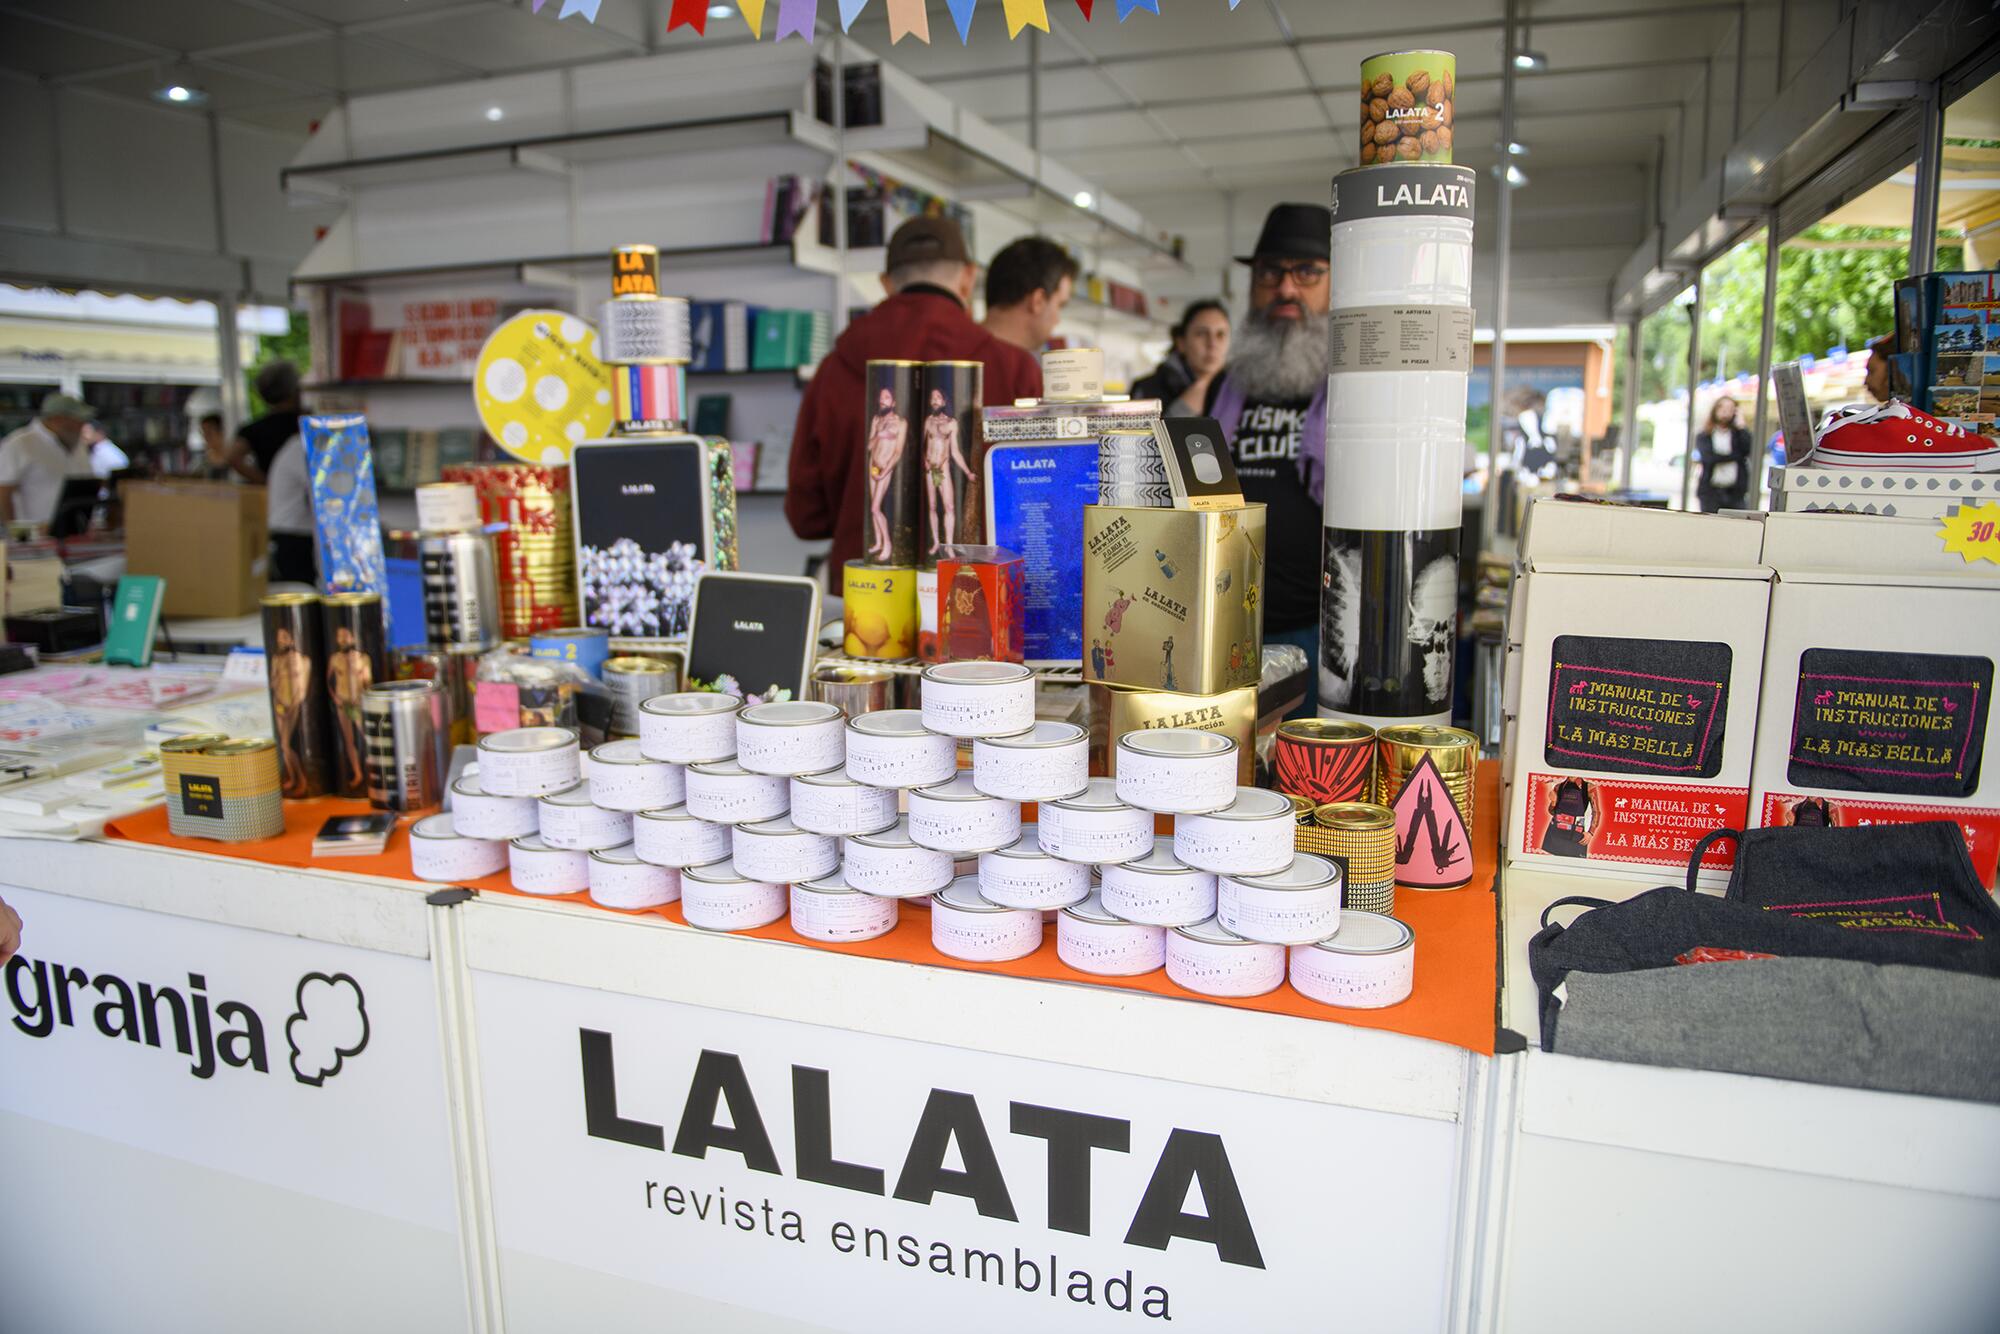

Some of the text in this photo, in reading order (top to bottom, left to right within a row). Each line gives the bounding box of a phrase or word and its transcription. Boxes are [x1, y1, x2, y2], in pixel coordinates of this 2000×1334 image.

[1386, 102, 1445, 122] LALATA 2
[1377, 183, 1469, 209] LALATA
[619, 251, 645, 272] LA
[613, 274, 657, 294] LATA
[1011, 459, 1057, 470] LALATA
[1966, 520, 1995, 543] 30
[883, 577, 894, 593] 2
[1144, 586, 1188, 617] LA LATA
[565, 642, 577, 660] 2
[1588, 681, 1684, 707] MANUAL DE
[1837, 690, 1939, 712] MANUAL DE
[1172, 705, 1223, 728] LATA
[1569, 696, 1697, 726] INSTRUCCIONES
[1815, 707, 1954, 730] INSTRUCCIONES
[1558, 725, 1694, 758] LA MAS BELLA
[1802, 737, 1953, 764] LA MAS BELLA
[1631, 798, 1711, 815] MANUAL DE
[1613, 811, 1726, 830] INSTRUCCIONES
[1605, 832, 1628, 848] LA
[1632, 834, 1669, 851] MÁS
[2, 953, 270, 1080] granja
[578, 1026, 1267, 1271] LALATA
[645, 1177, 1173, 1322] revista ensamblada
